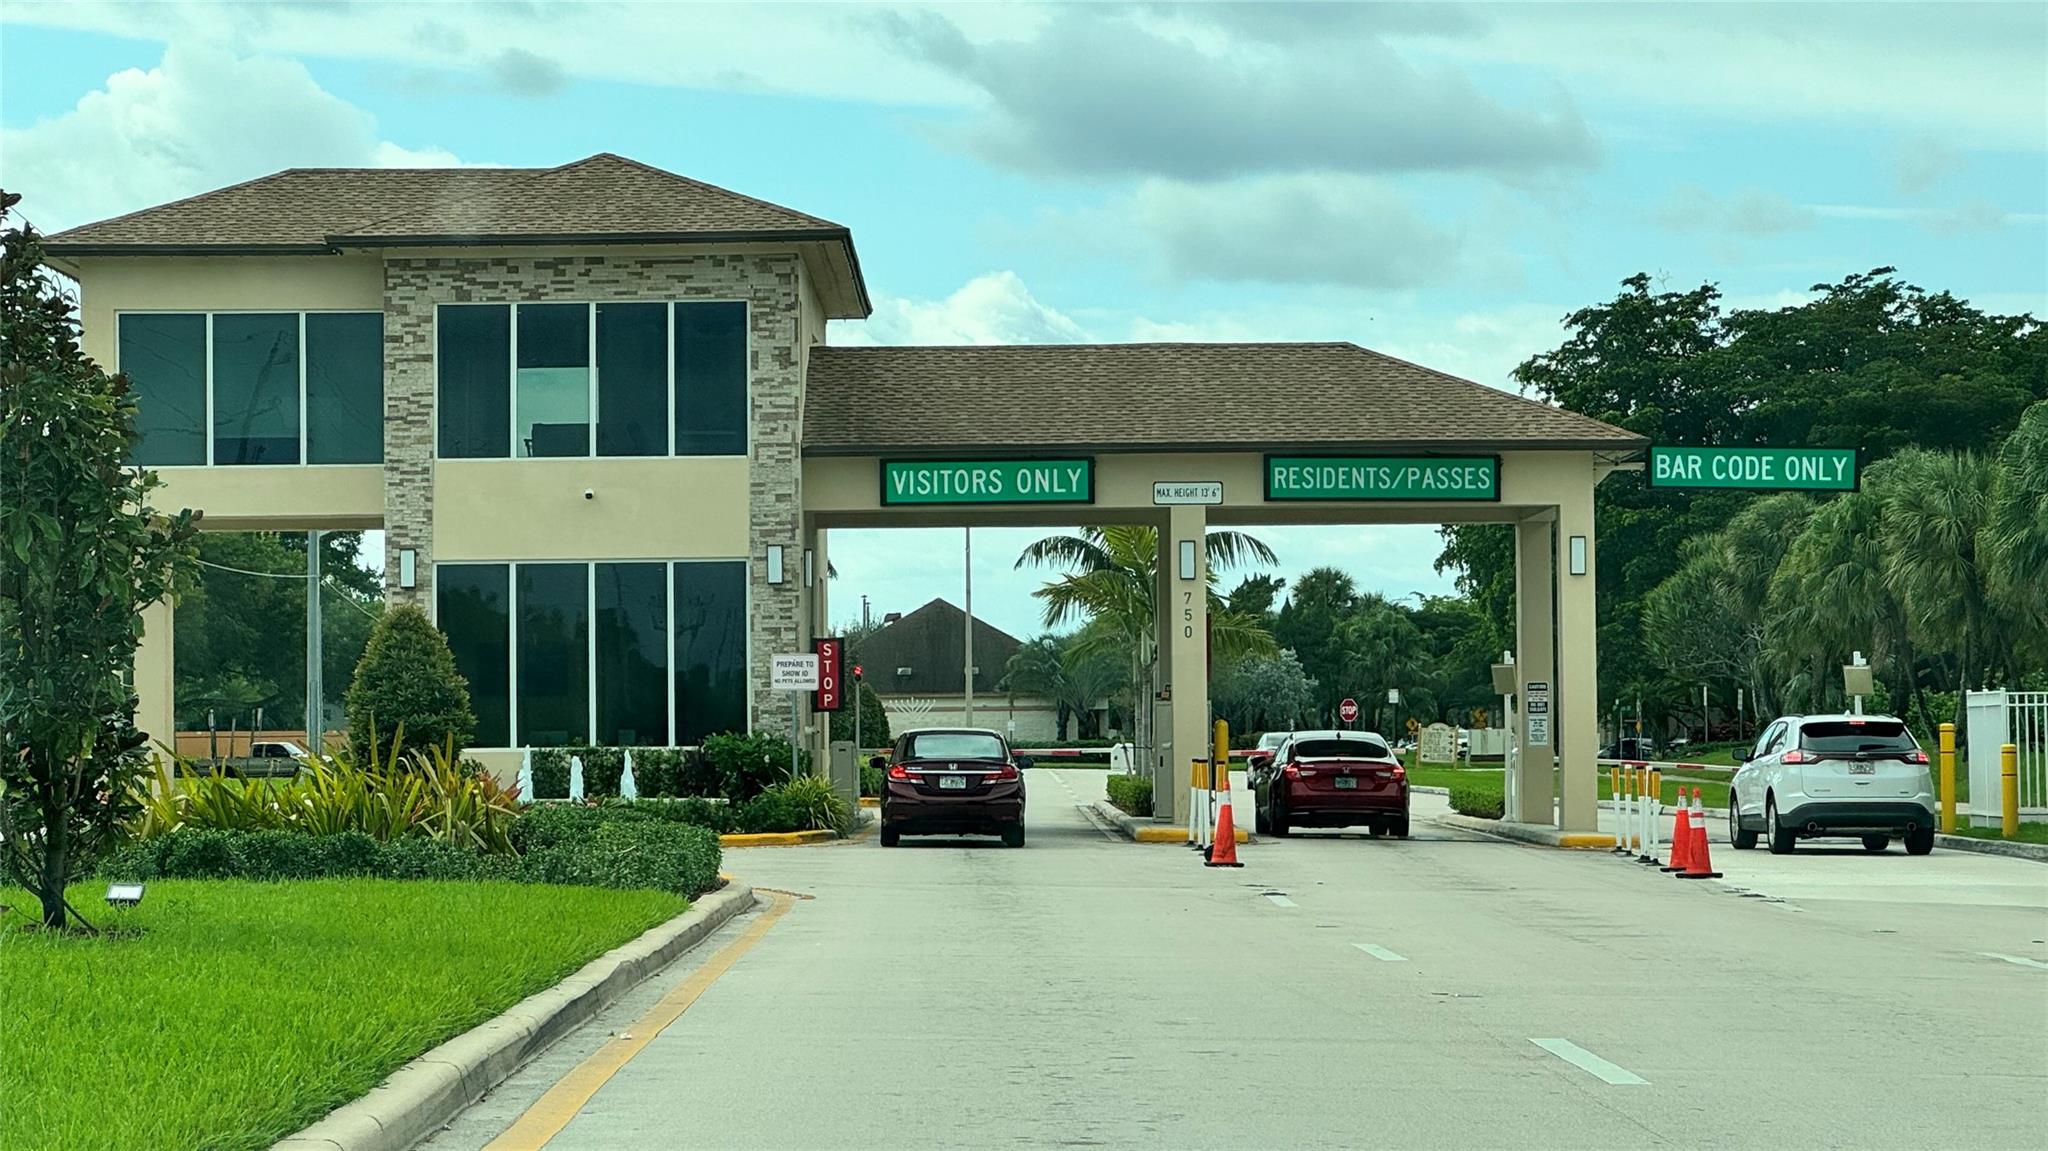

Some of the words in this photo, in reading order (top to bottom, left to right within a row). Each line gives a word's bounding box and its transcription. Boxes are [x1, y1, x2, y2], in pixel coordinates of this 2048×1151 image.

[1273, 466, 1490, 490] RESIDENTS/PASSES
[1656, 454, 1702, 480] BAR
[1712, 454, 1776, 481] CODE
[1784, 455, 1848, 482] ONLY
[892, 468, 1003, 496] VISITORS
[1016, 467, 1082, 494] ONLY
[1156, 487, 1172, 498] MAX.
[1174, 487, 1198, 498] HEIGHT
[1183, 592, 1193, 639] 750
[776, 660, 804, 668] PREPARE
[805, 660, 814, 668] TO
[823, 643, 833, 707] STOP
[1341, 705, 1357, 716] STOP
